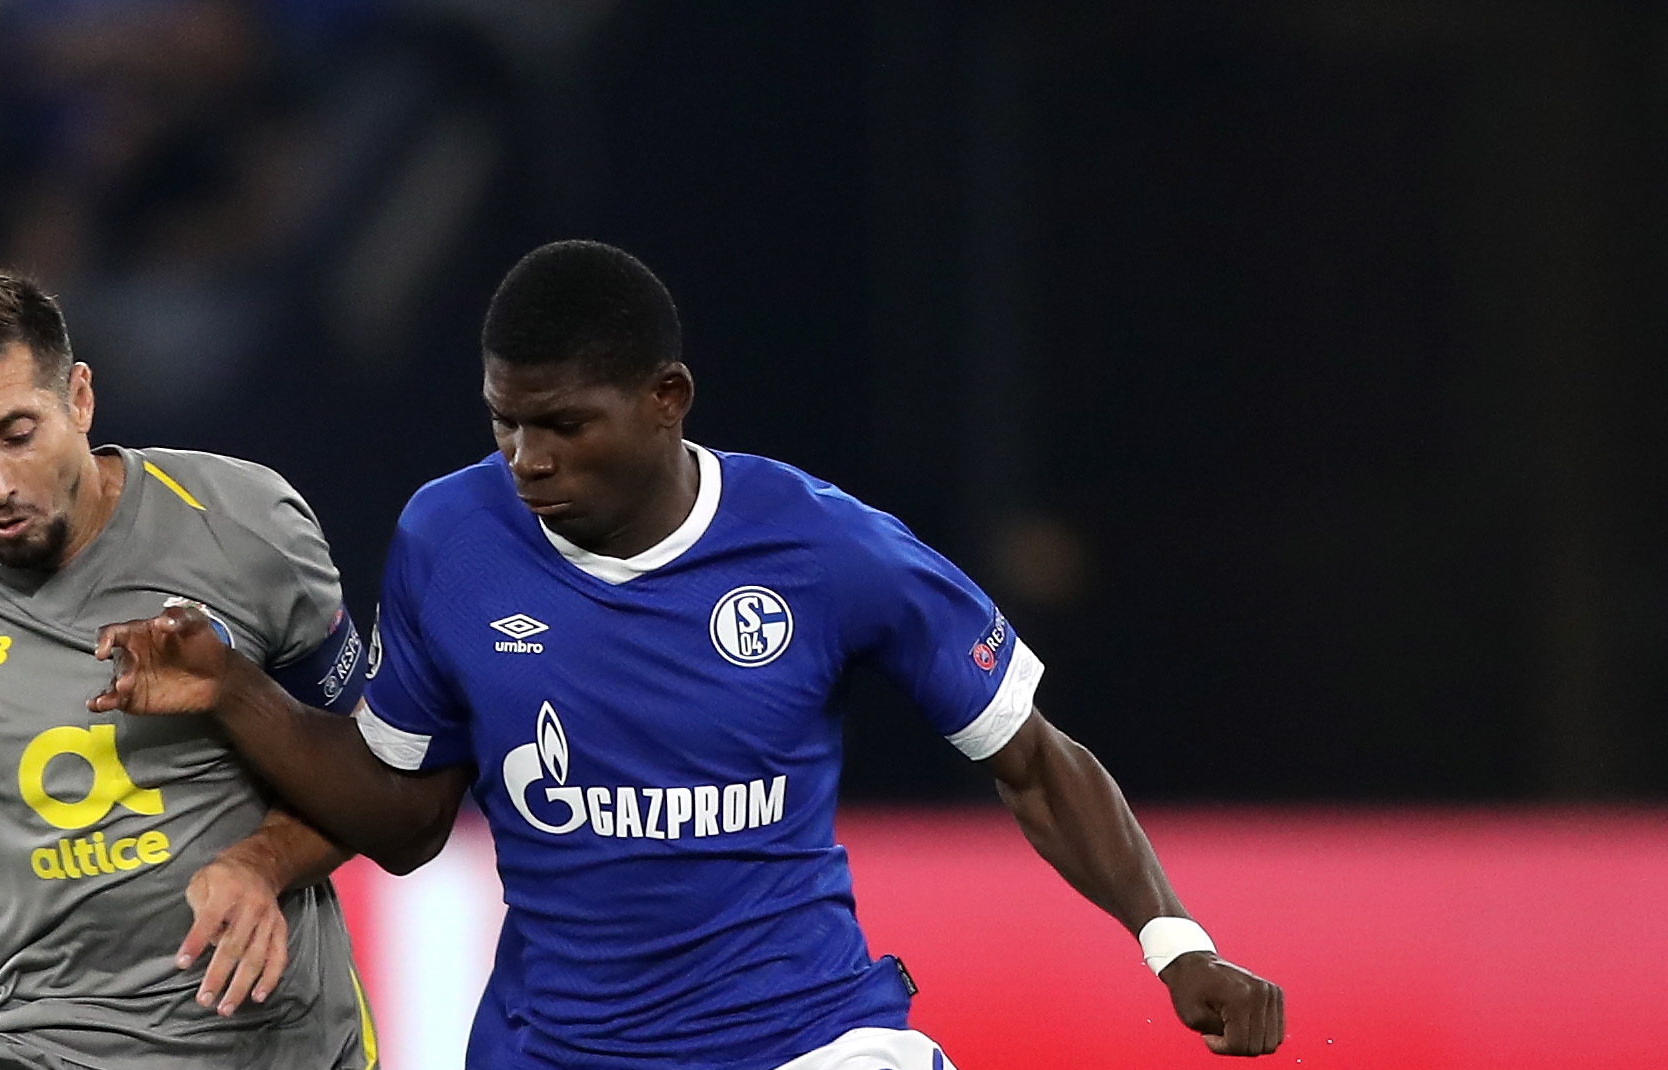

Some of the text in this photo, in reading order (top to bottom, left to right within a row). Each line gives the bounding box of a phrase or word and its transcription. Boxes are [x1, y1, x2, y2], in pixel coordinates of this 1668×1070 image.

[495, 640, 544, 654] umbro
[586, 765, 787, 840] GAZPROM
[31, 831, 171, 880] altice
